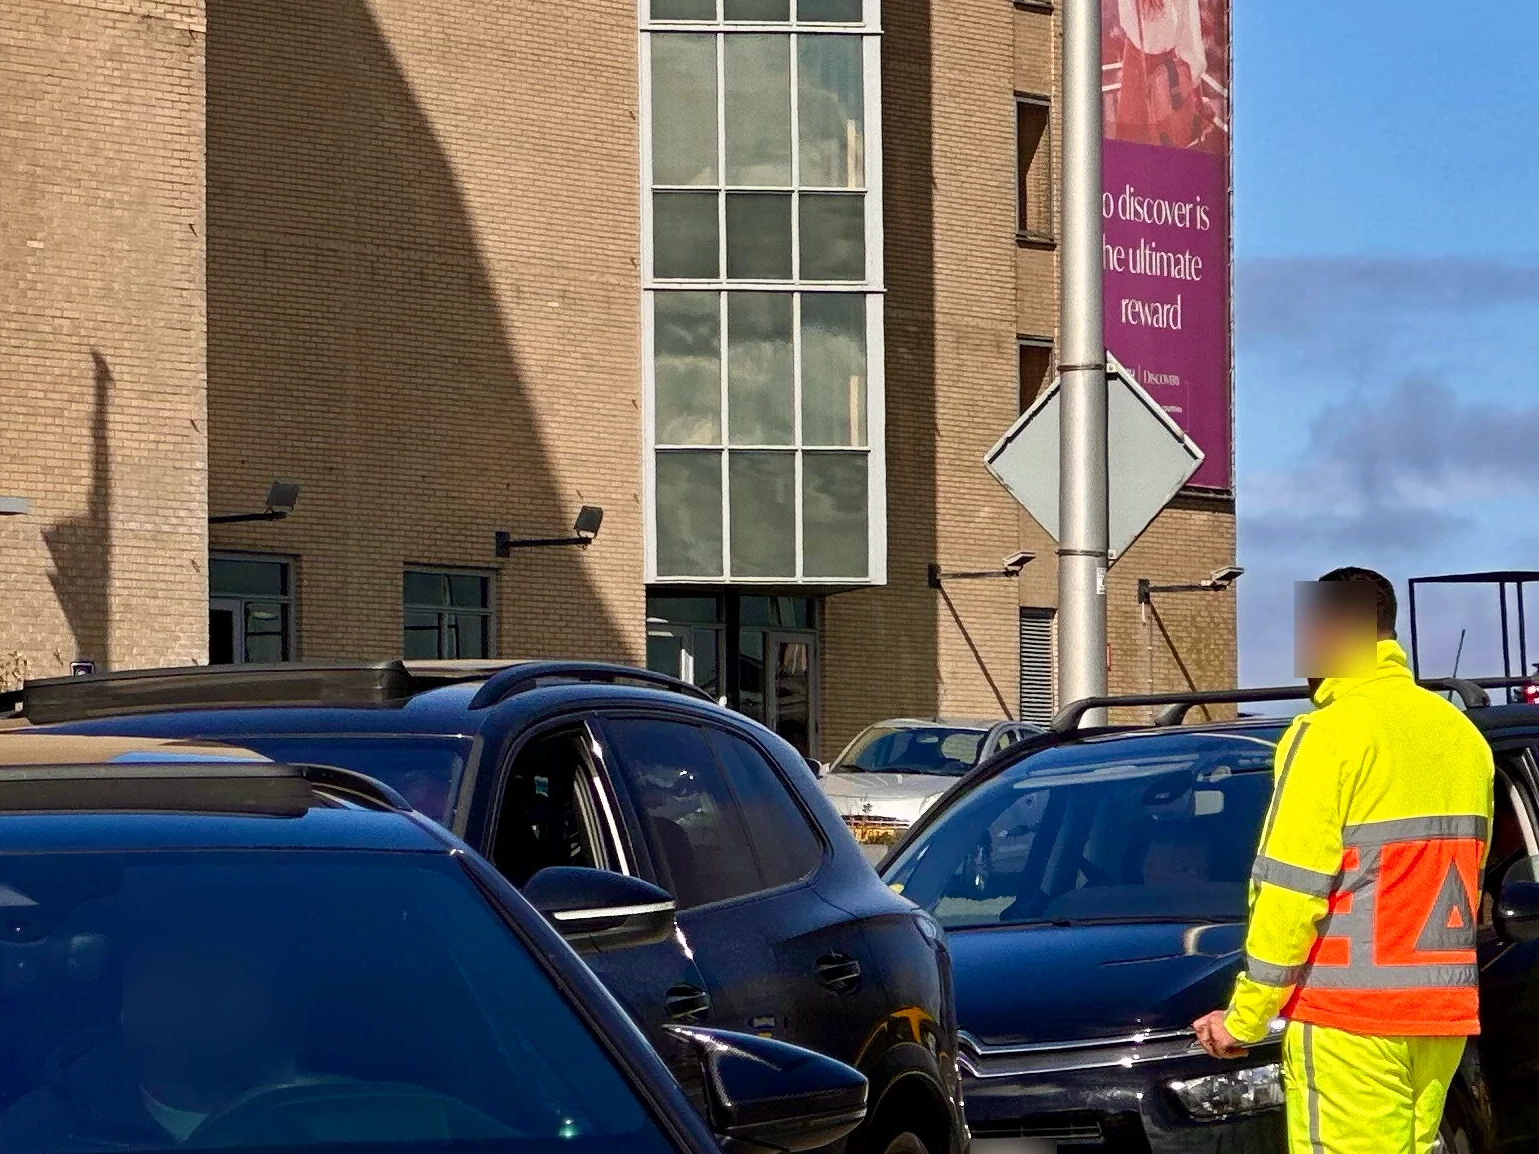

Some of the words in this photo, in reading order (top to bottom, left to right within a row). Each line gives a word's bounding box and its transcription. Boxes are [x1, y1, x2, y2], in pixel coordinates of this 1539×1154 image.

[1102, 191, 1114, 219] o
[1118, 184, 1193, 229] discover
[1195, 195, 1211, 231] is
[1102, 233, 1125, 273] he
[1128, 238, 1203, 281] ultimate
[1120, 294, 1182, 330] reward
